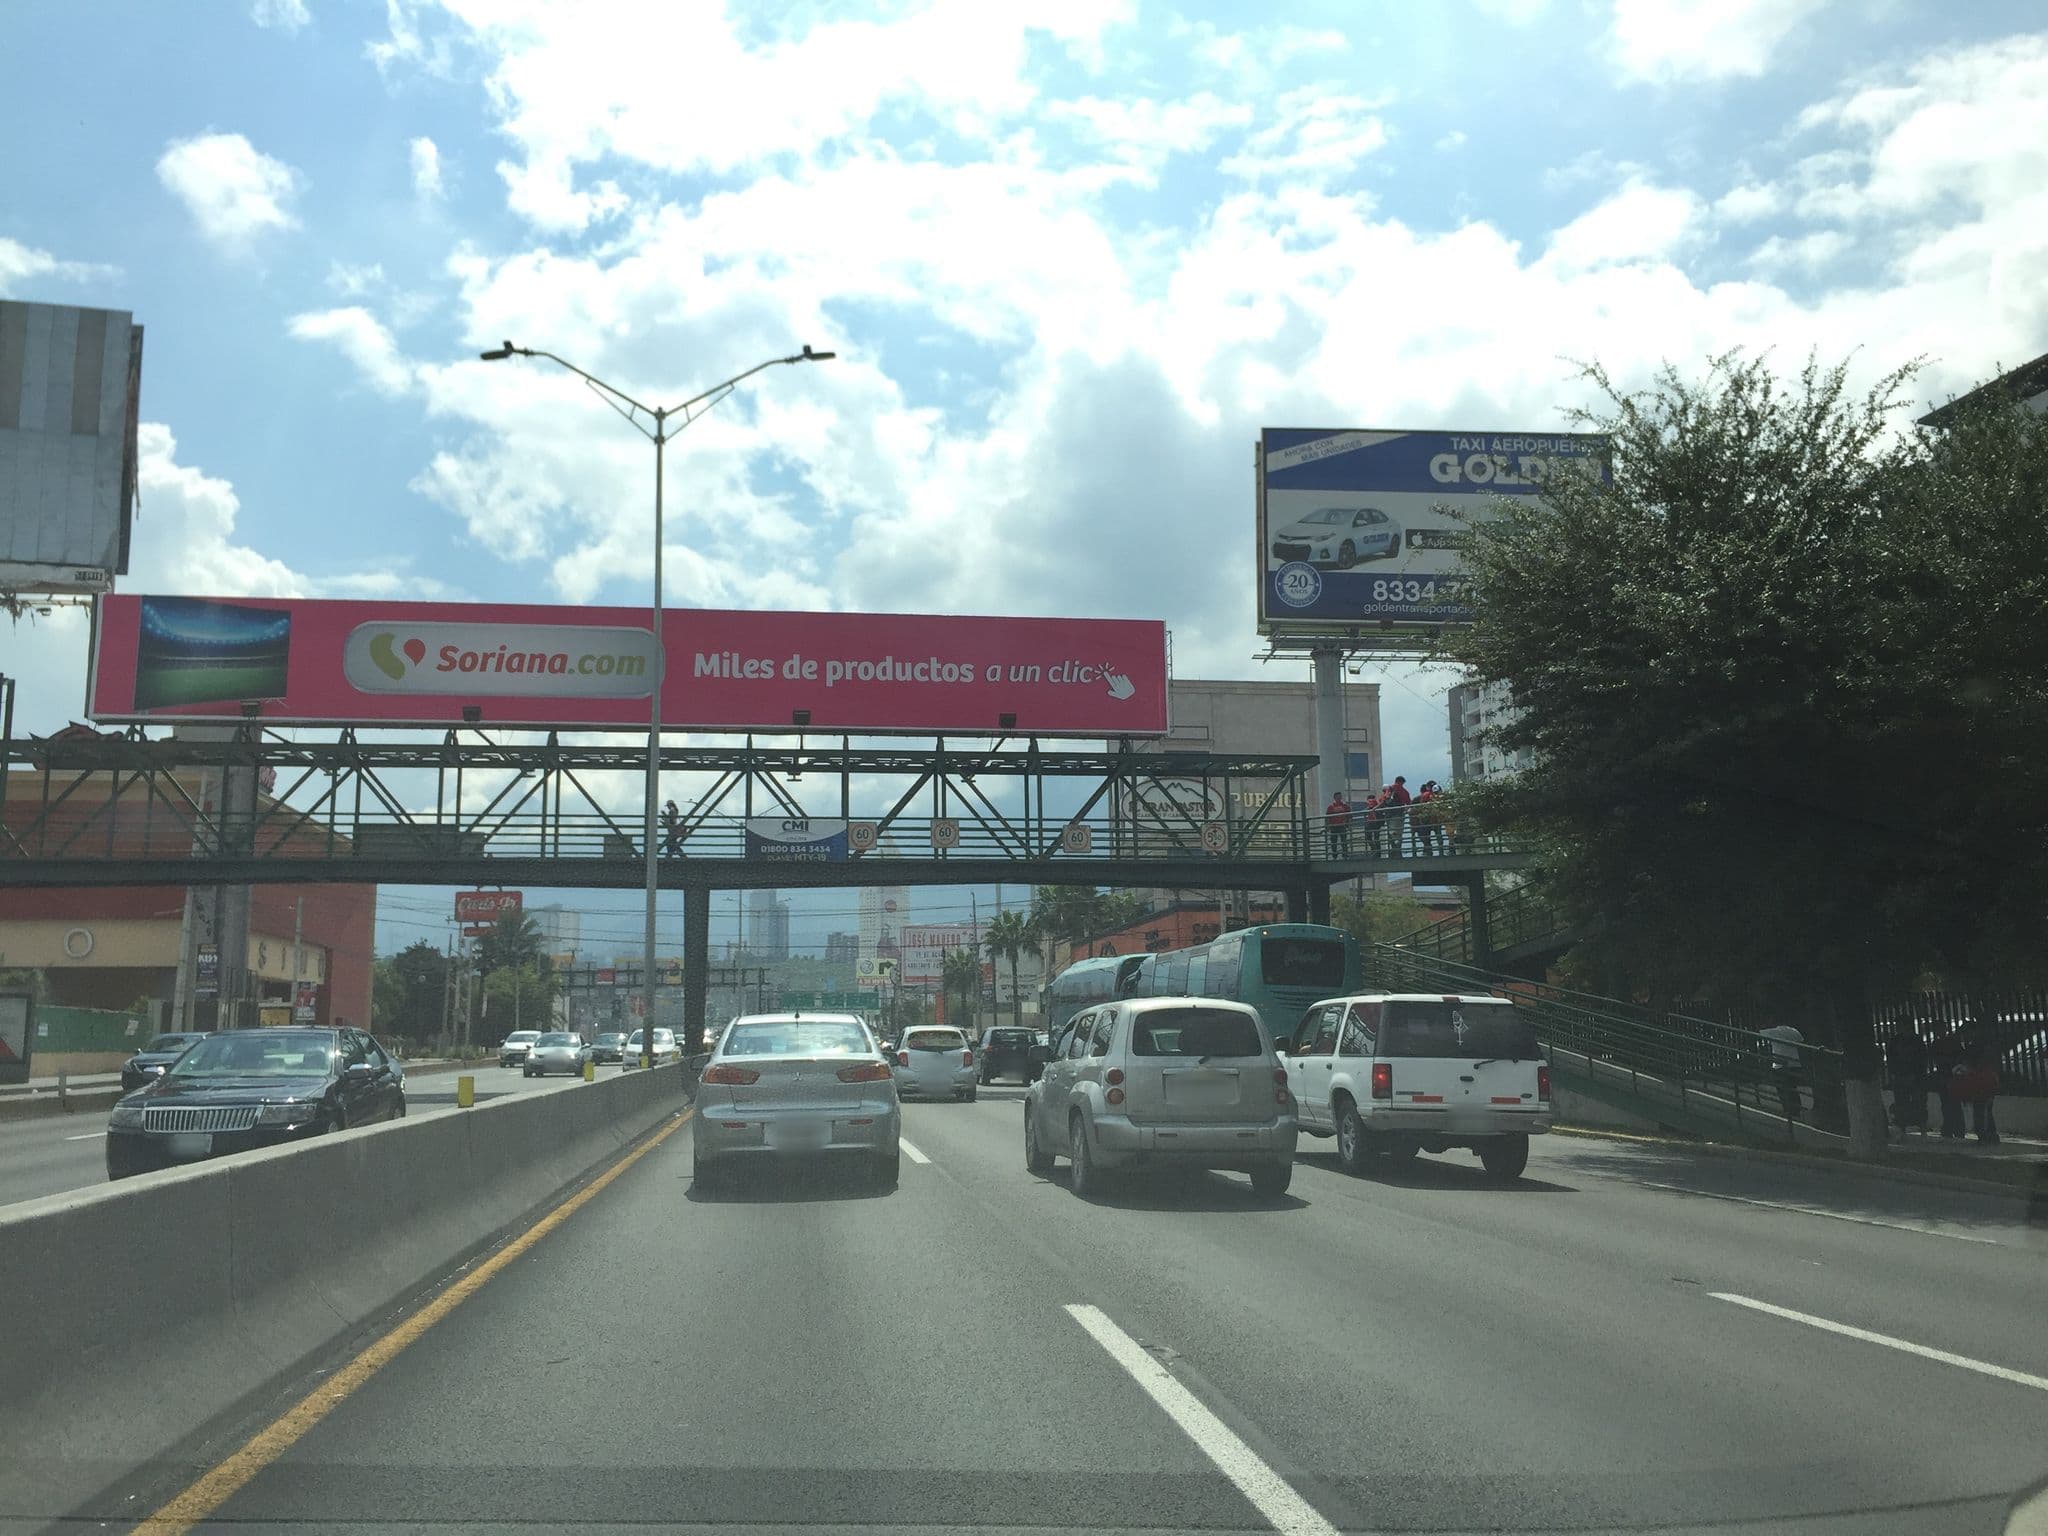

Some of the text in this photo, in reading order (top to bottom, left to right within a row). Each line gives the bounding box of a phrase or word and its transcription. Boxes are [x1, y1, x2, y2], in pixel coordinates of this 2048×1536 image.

[1451, 437, 1485, 451] TAXI
[1288, 574, 1308, 588] 20
[436, 644, 646, 678] Soriana.com
[693, 651, 1093, 688] Miles de productos a un clic
[781, 820, 809, 832] CMI
[856, 829, 869, 840] 60
[938, 827, 952, 838] 60
[1070, 832, 1084, 843] 60
[790, 845, 806, 853] 834
[808, 845, 831, 853] 3434
